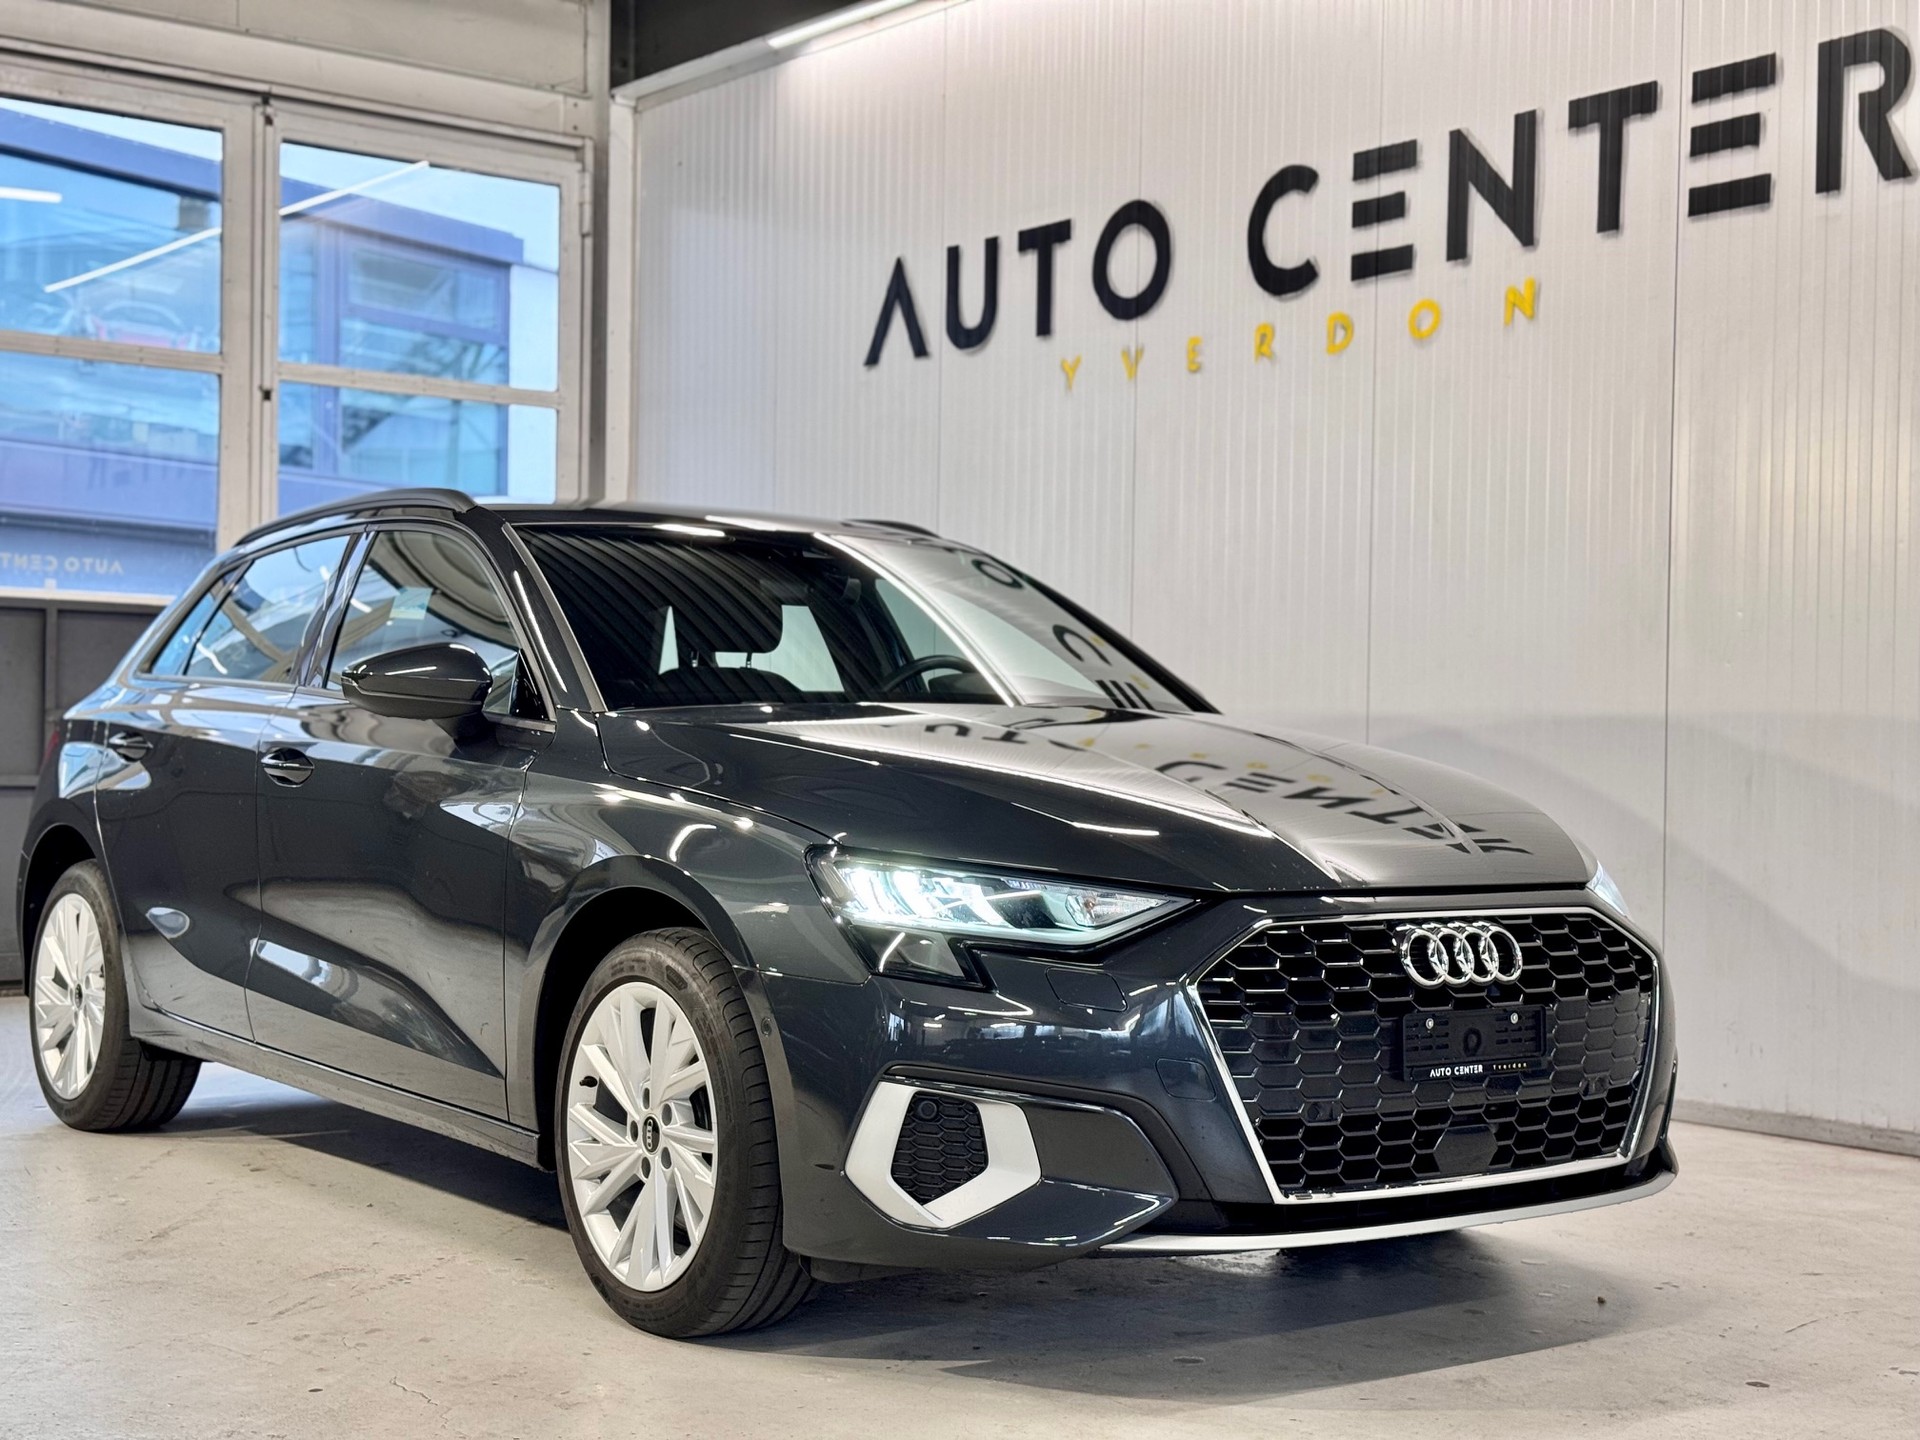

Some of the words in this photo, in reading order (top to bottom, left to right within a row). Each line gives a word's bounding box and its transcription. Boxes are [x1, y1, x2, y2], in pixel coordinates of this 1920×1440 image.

[864, 199, 1173, 367] AUTO
[1247, 28, 1914, 298] CENTER
[1061, 277, 1538, 390] YVERDON
[1429, 1067, 1452, 1078] AUTO
[1454, 1064, 1484, 1076] CENTER
